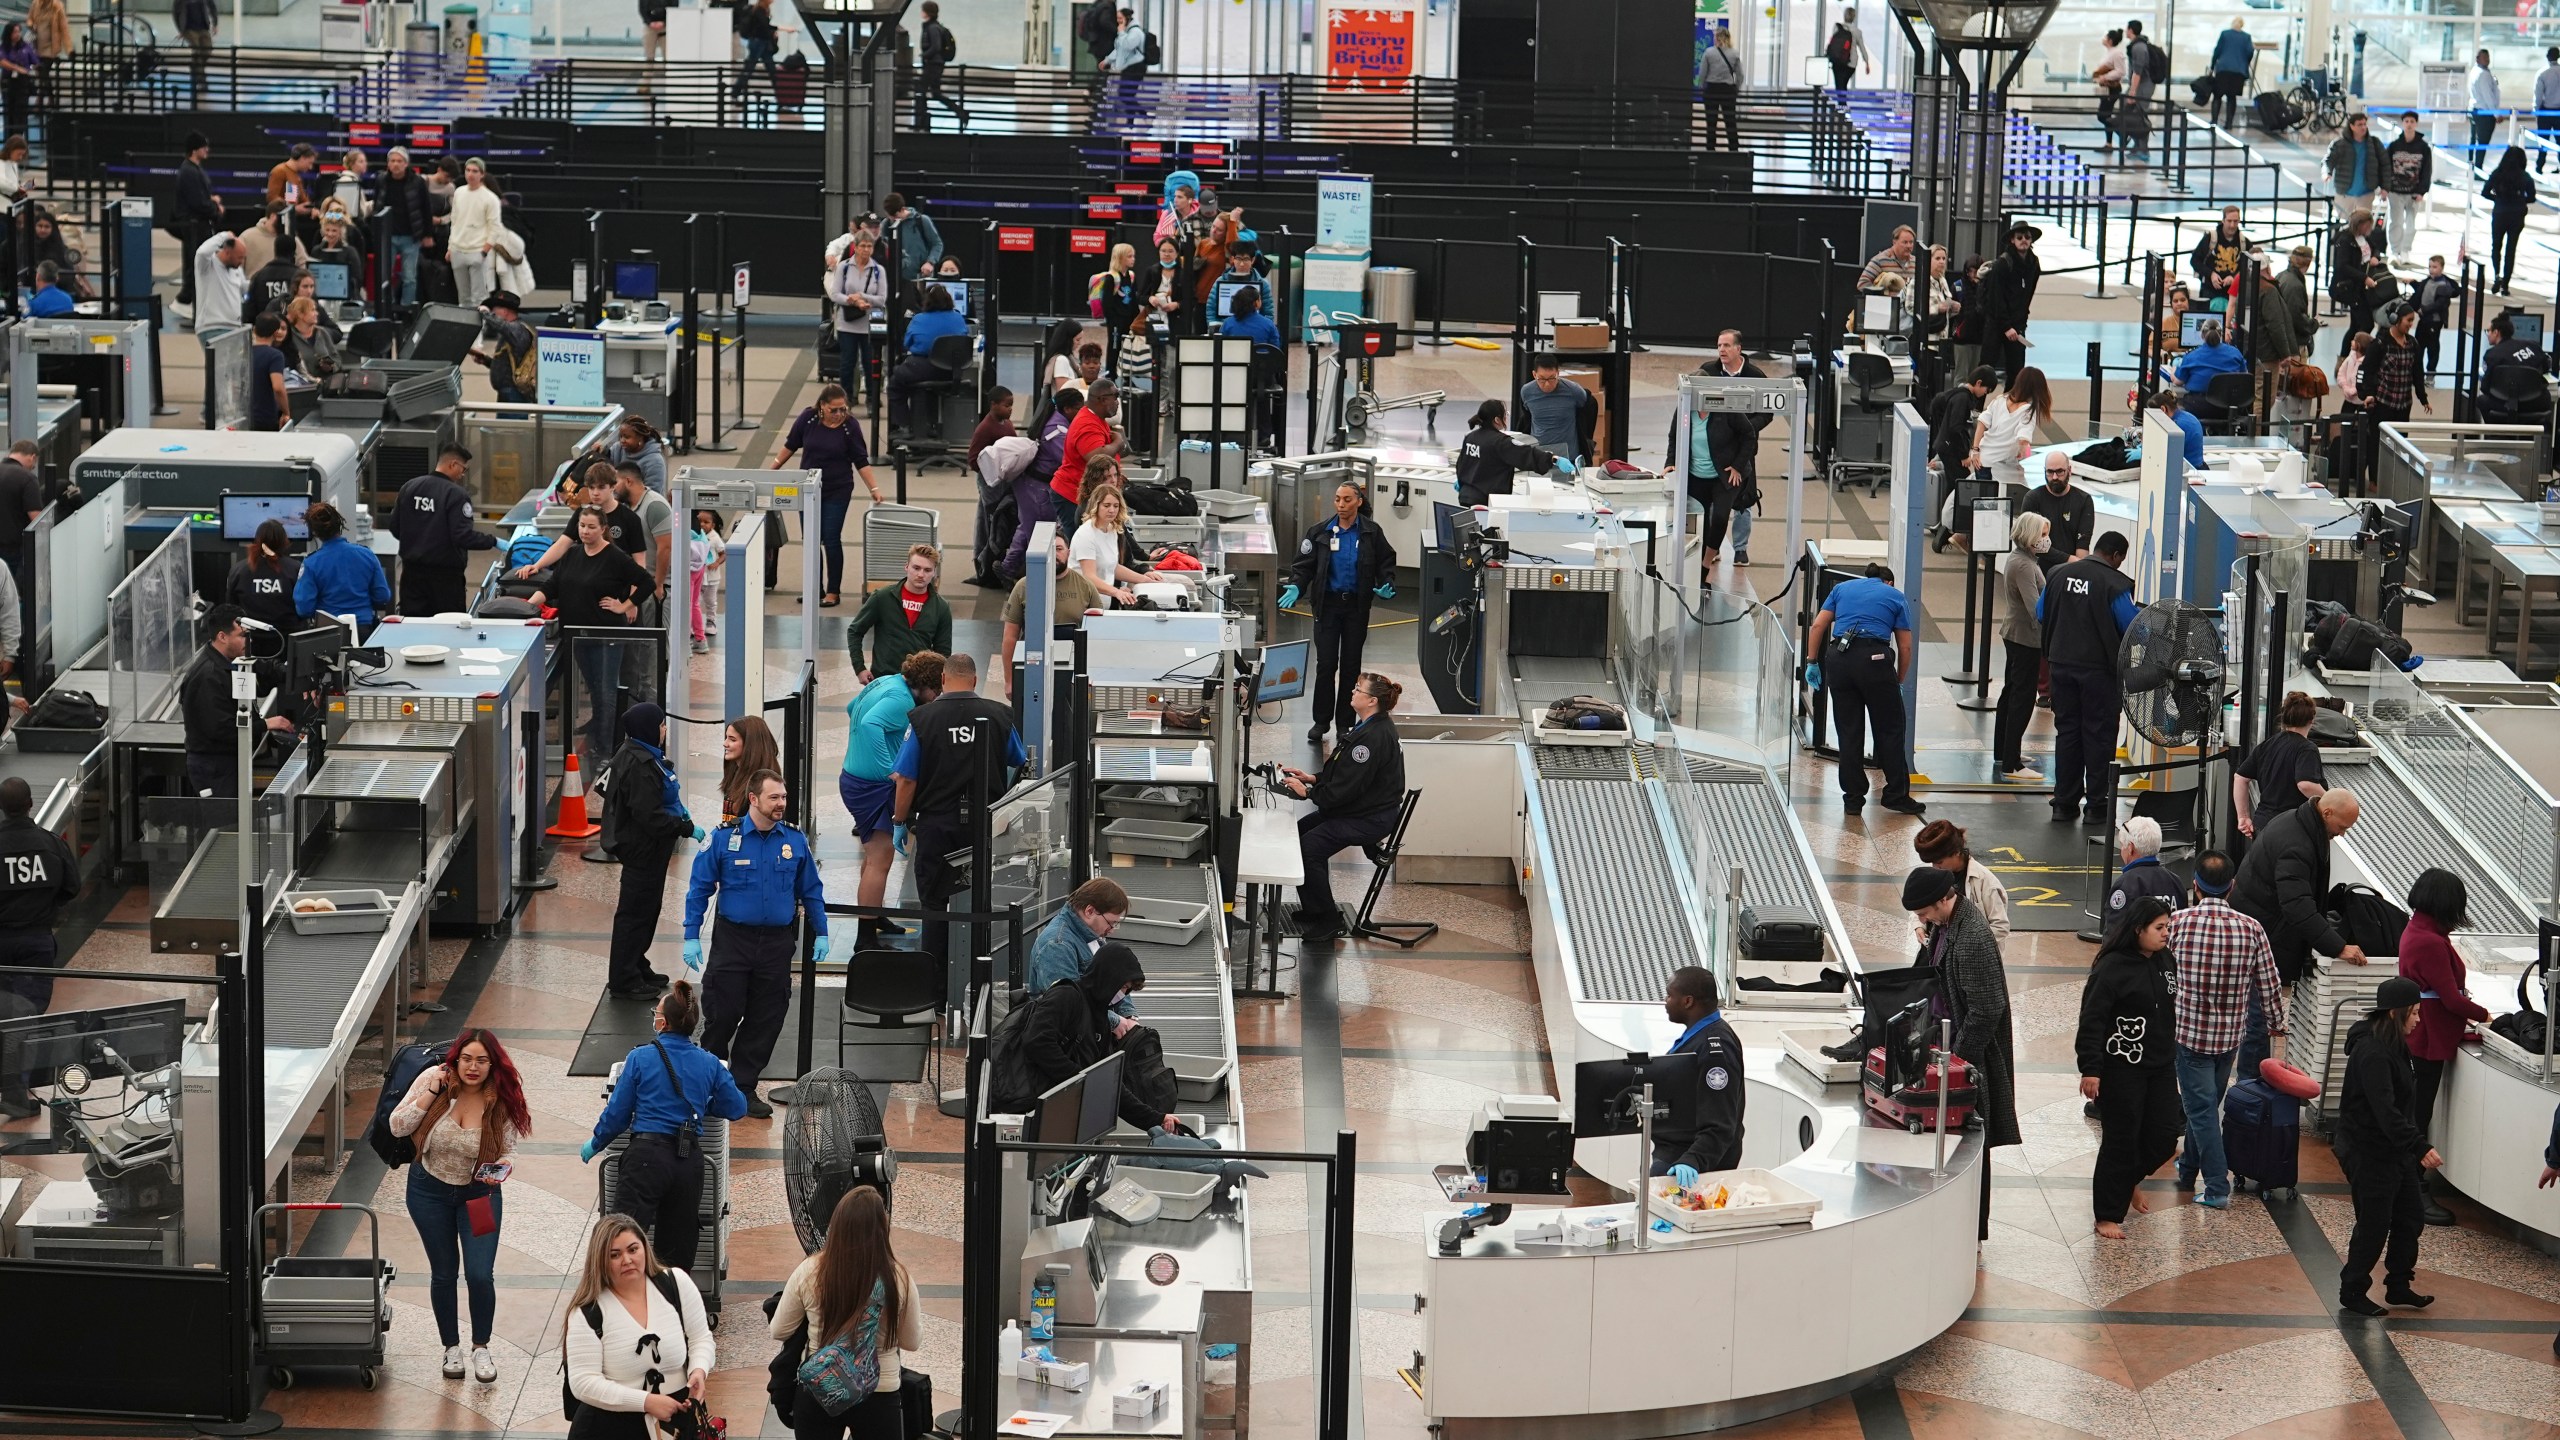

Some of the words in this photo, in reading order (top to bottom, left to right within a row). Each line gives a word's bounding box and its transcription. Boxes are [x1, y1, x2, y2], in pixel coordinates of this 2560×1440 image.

[1336, 32, 1405, 50] Merry
[1335, 48, 1404, 70] Bright
[1322, 191, 1361, 201] WASTE!
[266, 281, 288, 298] TSA
[542, 351, 591, 365] WASTE!
[2513, 346, 2535, 362] TSA
[1763, 393, 1786, 410] 10
[1465, 442, 1480, 459] TSA
[82, 469, 121, 479] smiths
[413, 496, 435, 513] TSA
[252, 578, 283, 594] TSA
[2066, 577, 2089, 595] TSA
[1223, 626, 1234, 643] 8
[236, 677, 249, 693] 7
[4, 855, 47, 884] TSA
[2005, 886, 2073, 907] 2
